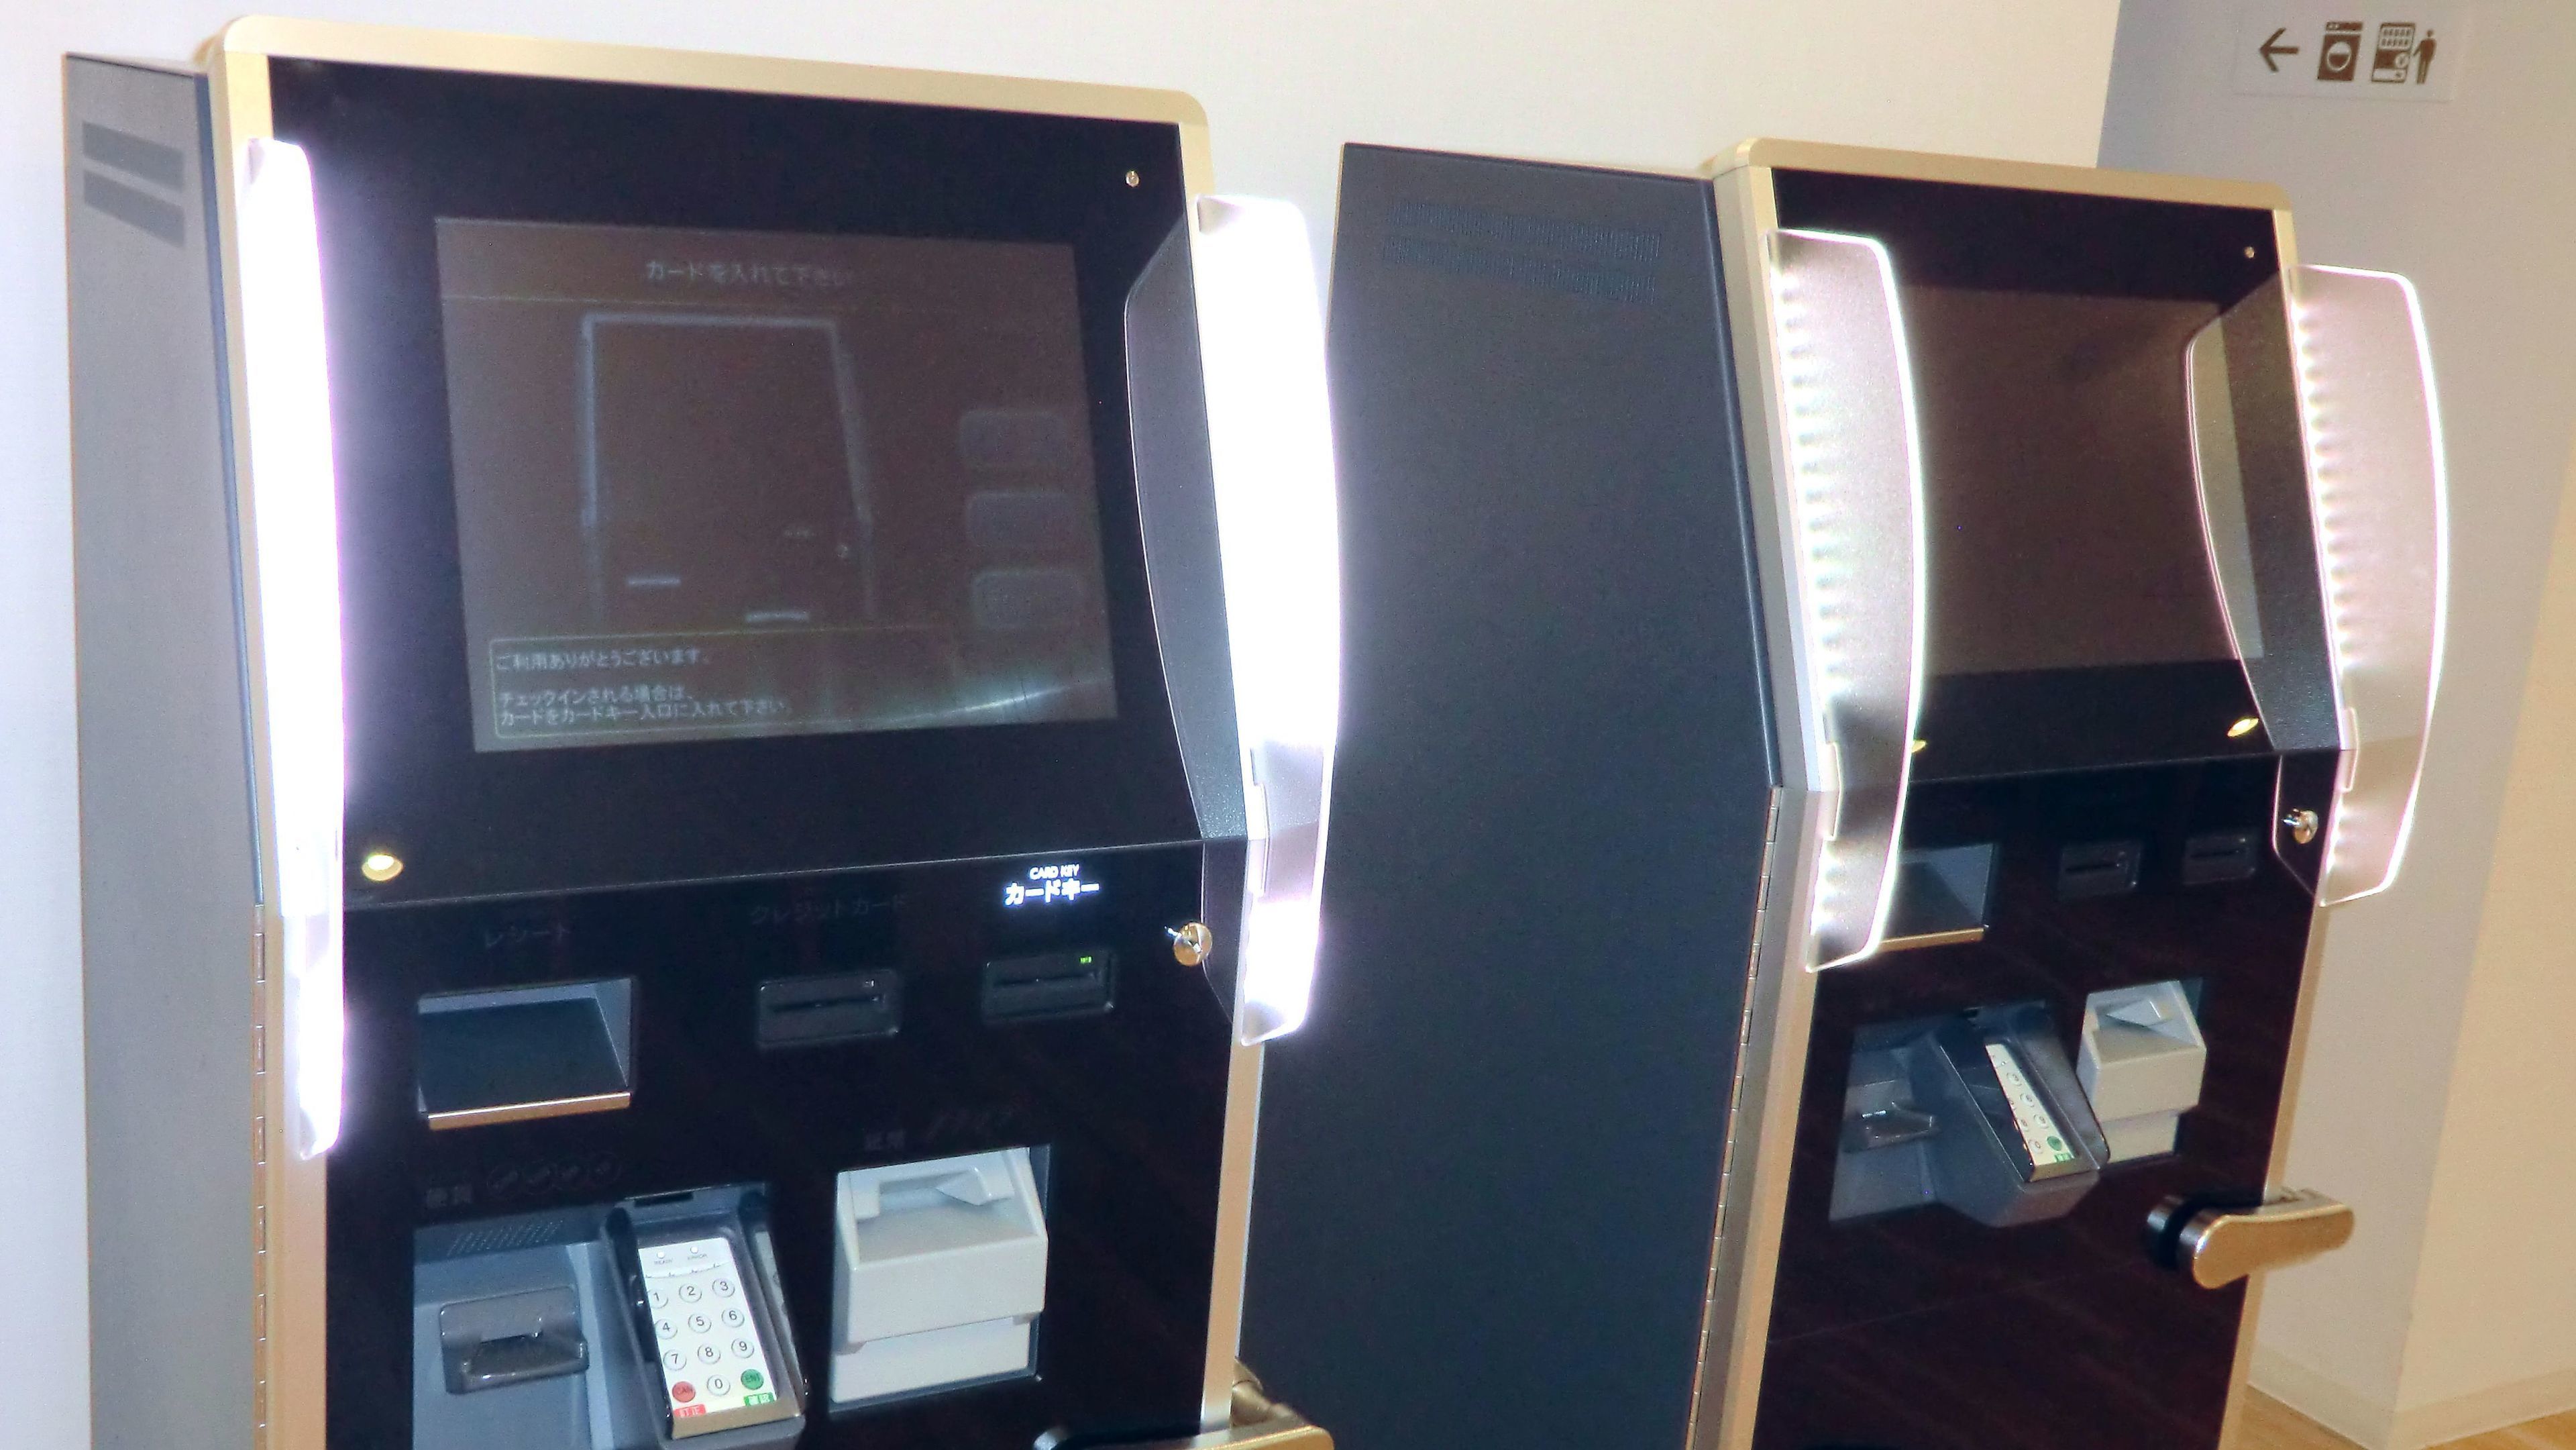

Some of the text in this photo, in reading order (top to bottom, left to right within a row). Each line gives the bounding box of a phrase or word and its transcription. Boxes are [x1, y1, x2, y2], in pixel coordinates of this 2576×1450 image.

[1030, 864, 1079, 880] CARD KEY
[1004, 878, 1099, 906] カードキー
[686, 1286, 696, 1296] 2
[719, 1281, 729, 1291] 3
[662, 1310, 737, 1332] 4 5 6
[672, 1341, 747, 1364] 7 8 9
[714, 1378, 723, 1389] 0
